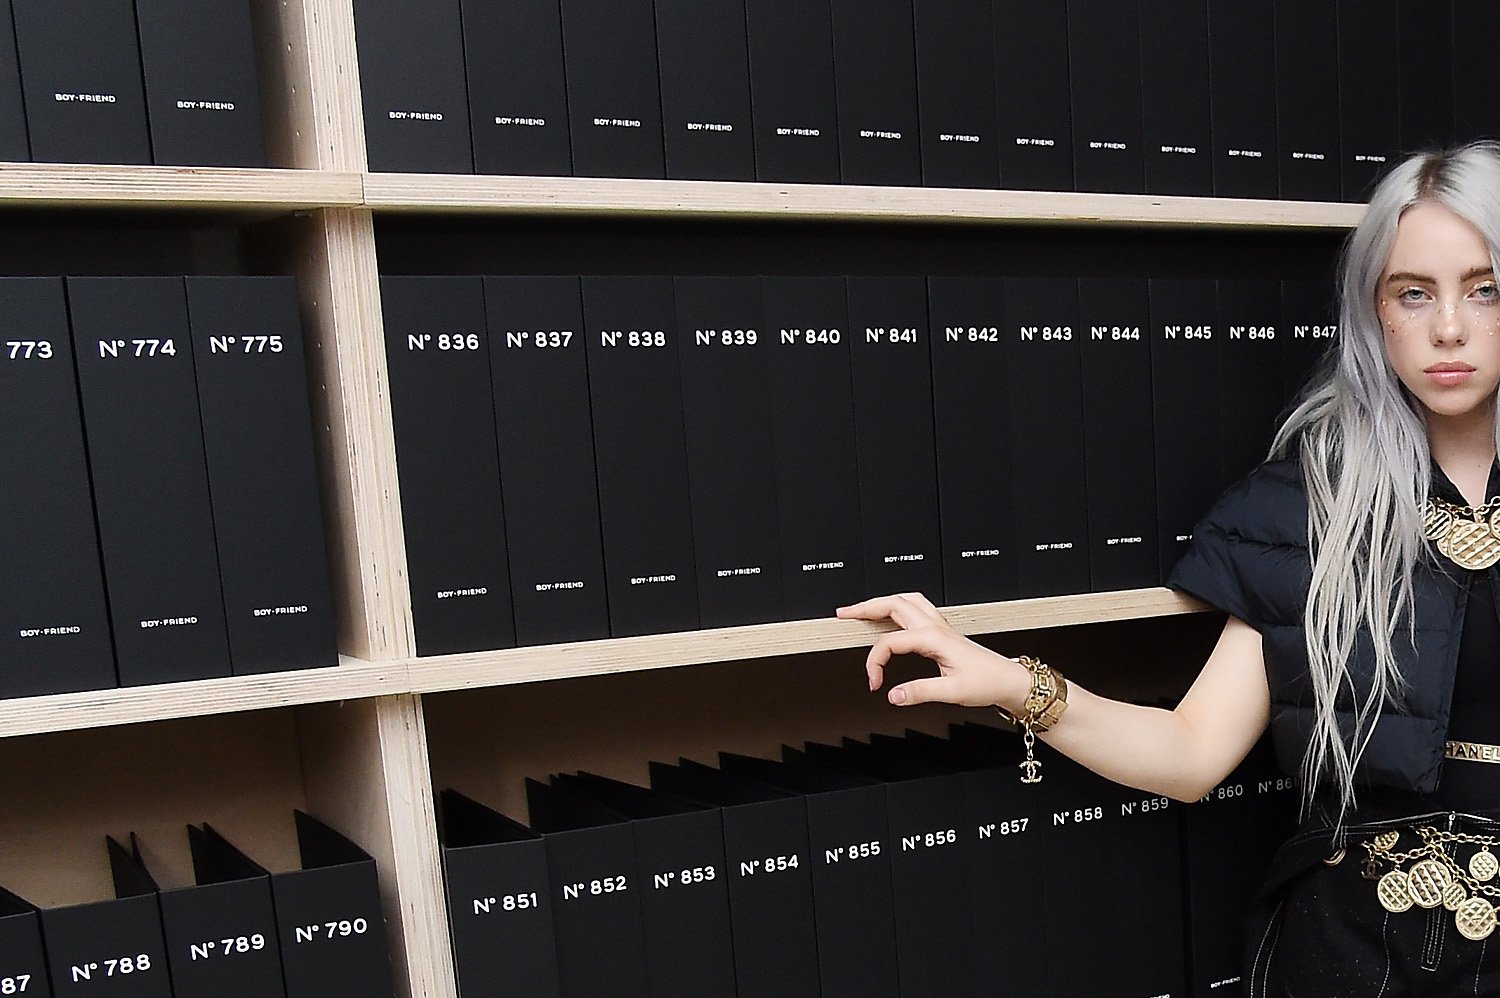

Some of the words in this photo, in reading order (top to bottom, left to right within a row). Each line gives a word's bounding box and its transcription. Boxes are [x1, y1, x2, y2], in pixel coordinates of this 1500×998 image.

[535, 331, 573, 348] 837
[628, 330, 666, 347] 838
[721, 329, 758, 346] 839
[805, 329, 841, 344] 840
[968, 327, 999, 342] 842
[1248, 326, 1275, 340] 846
[1312, 325, 1338, 339] 847
[6, 340, 53, 360] 773
[131, 339, 177, 357] 774
[241, 335, 283, 353] 775
[438, 333, 479, 351] 836
[1074, 806, 1103, 823] 858
[1000, 817, 1029, 835] 857
[764, 854, 799, 873] 854
[680, 865, 716, 885] 853
[590, 875, 627, 895] 852
[502, 892, 538, 911] 851
[324, 917, 368, 939] 790
[220, 933, 265, 956] 789
[103, 953, 151, 977] 788
[0, 974, 31, 995] 87
